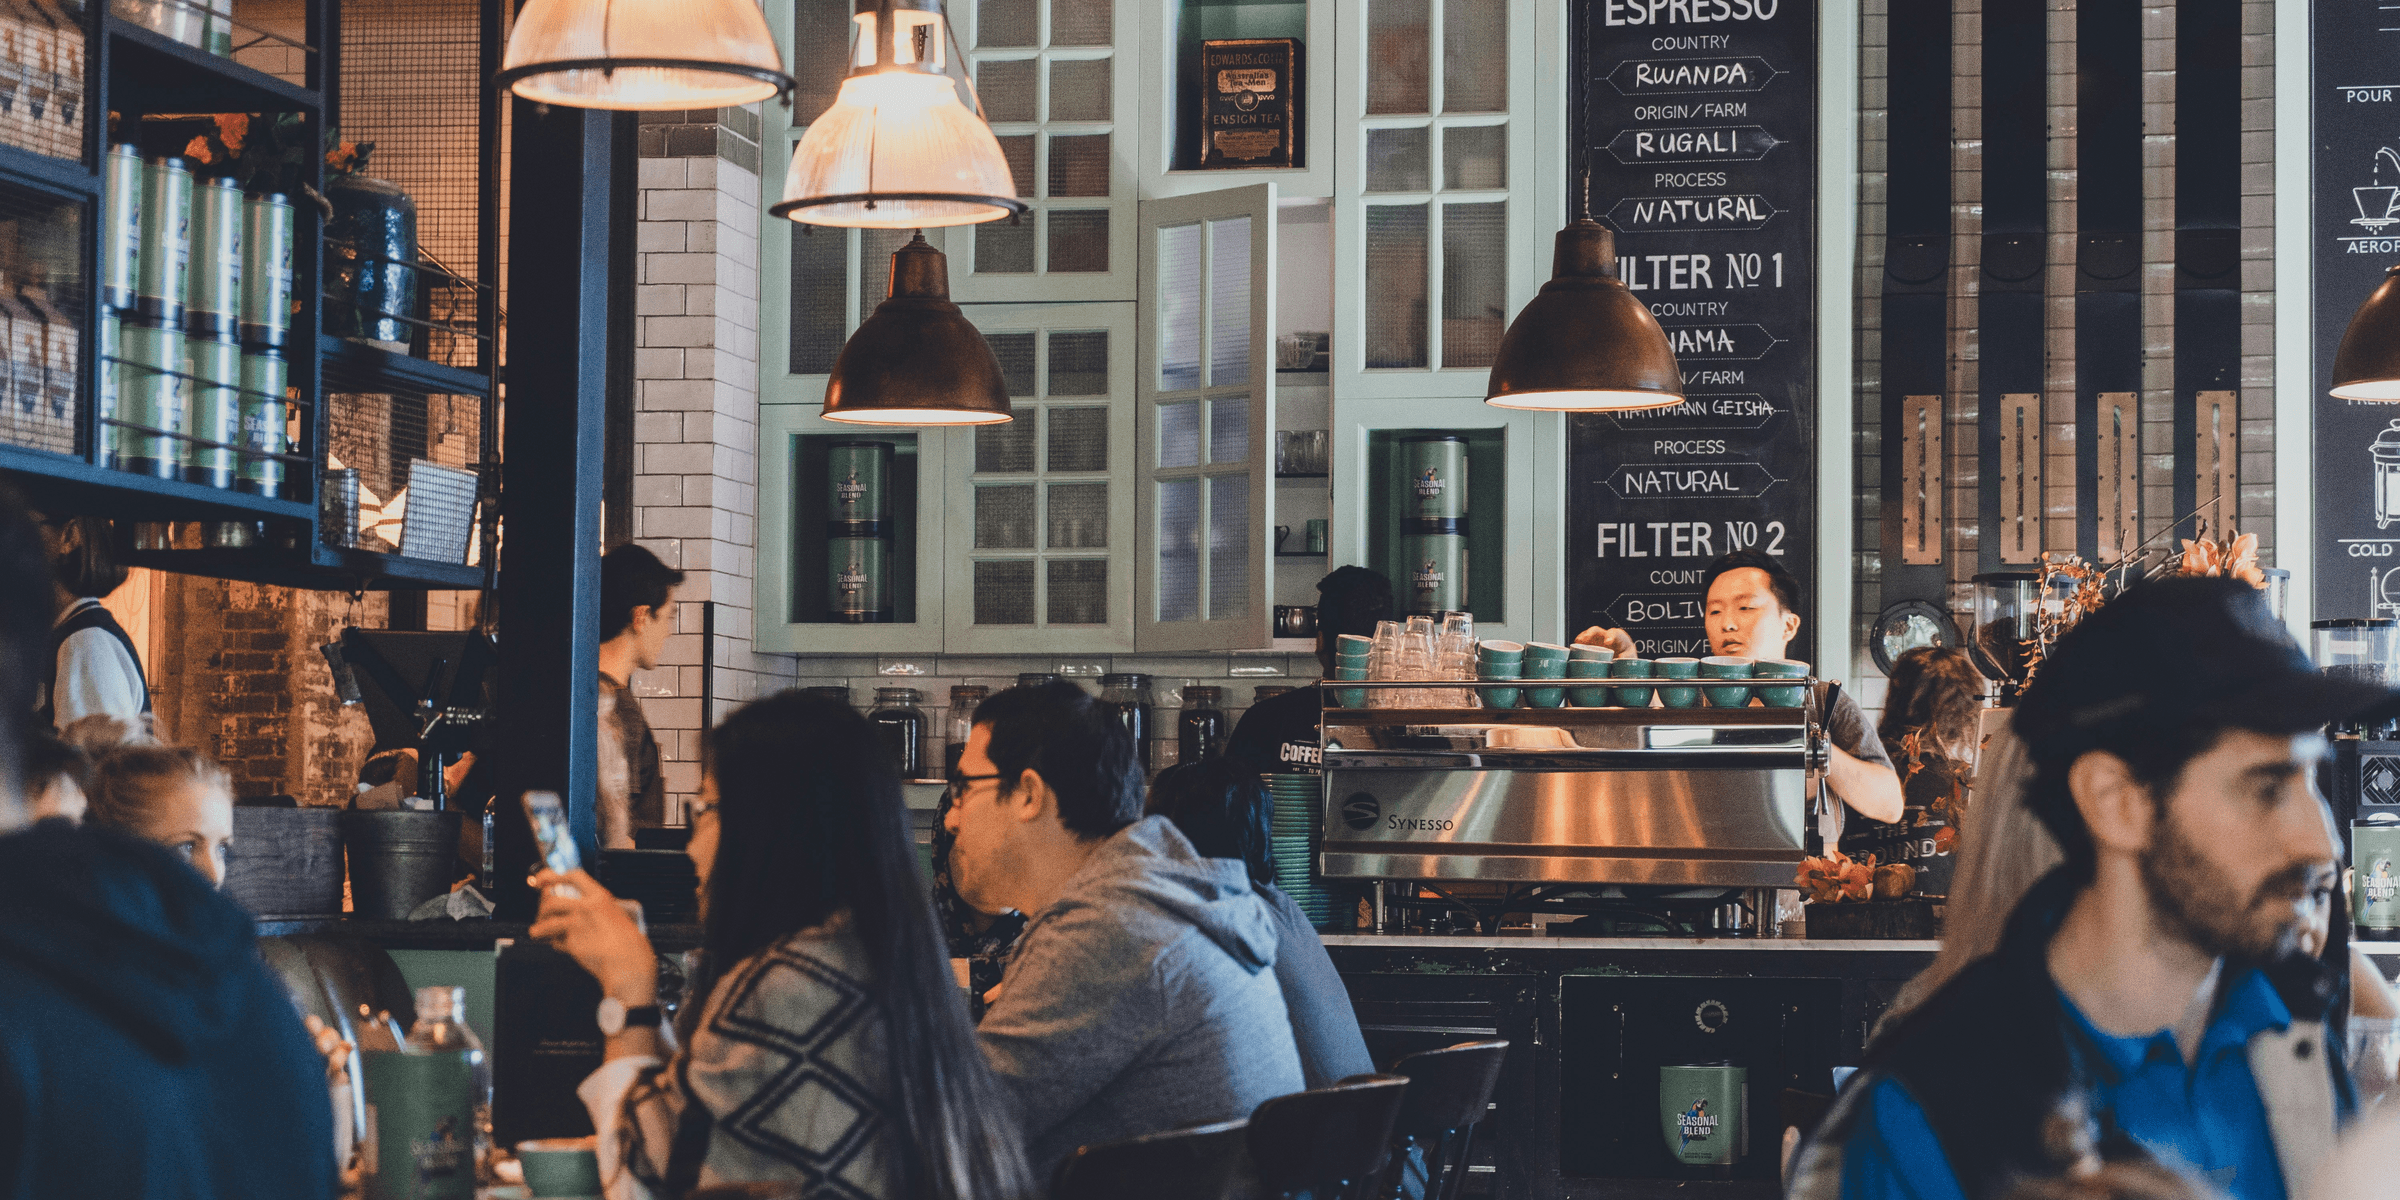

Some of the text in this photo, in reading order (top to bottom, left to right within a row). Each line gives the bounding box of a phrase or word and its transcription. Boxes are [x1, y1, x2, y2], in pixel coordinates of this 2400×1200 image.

[1605, 0, 1778, 26] ESPRESSO
[1652, 35, 1729, 51] COUNTRY
[1636, 63, 1747, 87] RWANDA
[2347, 89, 2392, 103] POUR
[1213, 113, 1281, 125] ENSIGN TEA
[1636, 130, 1737, 157] RUGALI
[1655, 172, 1727, 188] PROCESS
[1634, 197, 1767, 223] NATURAL
[1614, 254, 1714, 290] ILTER
[1772, 252, 1783, 288] 1
[1651, 301, 1729, 317] COUNTRY
[1669, 329, 1735, 353] NAMA
[1679, 370, 1744, 385] N/FARM
[1712, 399, 1774, 416] GEISHA
[1654, 440, 1726, 455] PROCESS
[836, 483, 868, 492] SEASONAL
[1413, 478, 1446, 488] SEASONAL
[1625, 470, 1740, 495] NATURAL
[1597, 522, 1714, 558] FILTER
[1765, 521, 1785, 556] 2
[2348, 543, 2393, 557] COLD
[837, 573, 868, 583] SEASONAL
[1412, 571, 1445, 581] SEASONAL
[1650, 569, 1706, 585] COUNT
[1626, 600, 1704, 622] BOLI
[1847, 837, 1949, 866] ROUND
[2368, 887, 2395, 897] BLEND
[1677, 1113, 1719, 1126] SEASONAL
[1683, 1126, 1711, 1135] BLEND
